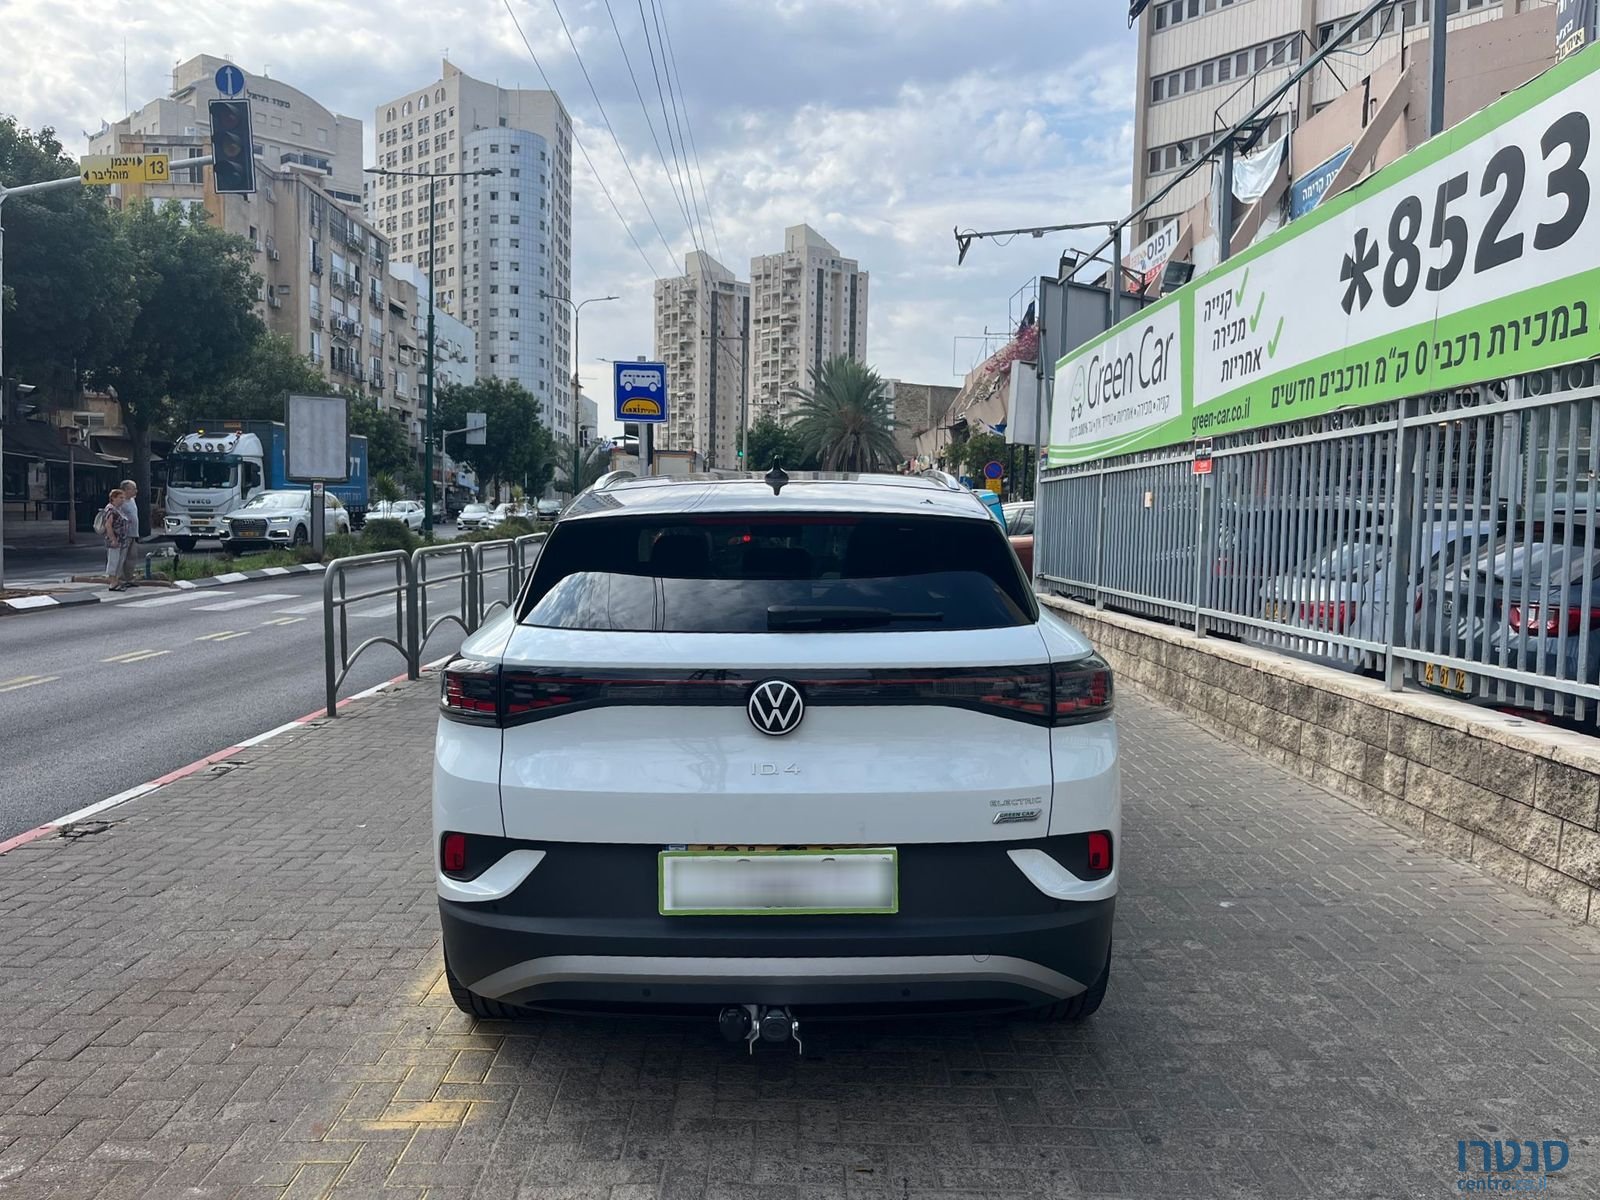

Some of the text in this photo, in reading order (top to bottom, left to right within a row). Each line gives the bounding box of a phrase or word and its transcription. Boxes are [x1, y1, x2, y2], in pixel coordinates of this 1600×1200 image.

[92, 168, 129, 180] מוהליבר
[110, 156, 136, 169] ויצמן
[149, 160, 164, 175] 13
[1302, 177, 1324, 201] קדימה
[1147, 228, 1172, 260] דפוס
[1203, 288, 1233, 322] קנייה
[1212, 317, 1246, 351] מכירה
[1486, 300, 1588, 358] במכירת
[1087, 325, 1174, 410] Green Car
[1221, 346, 1263, 383] אחריות
[1415, 340, 1428, 376] 0
[1434, 331, 1481, 370] רכבי
[1271, 377, 1315, 409] חדשים
[1319, 360, 1369, 397] ורכבים
[1191, 397, 1251, 435] green-car.co.il
